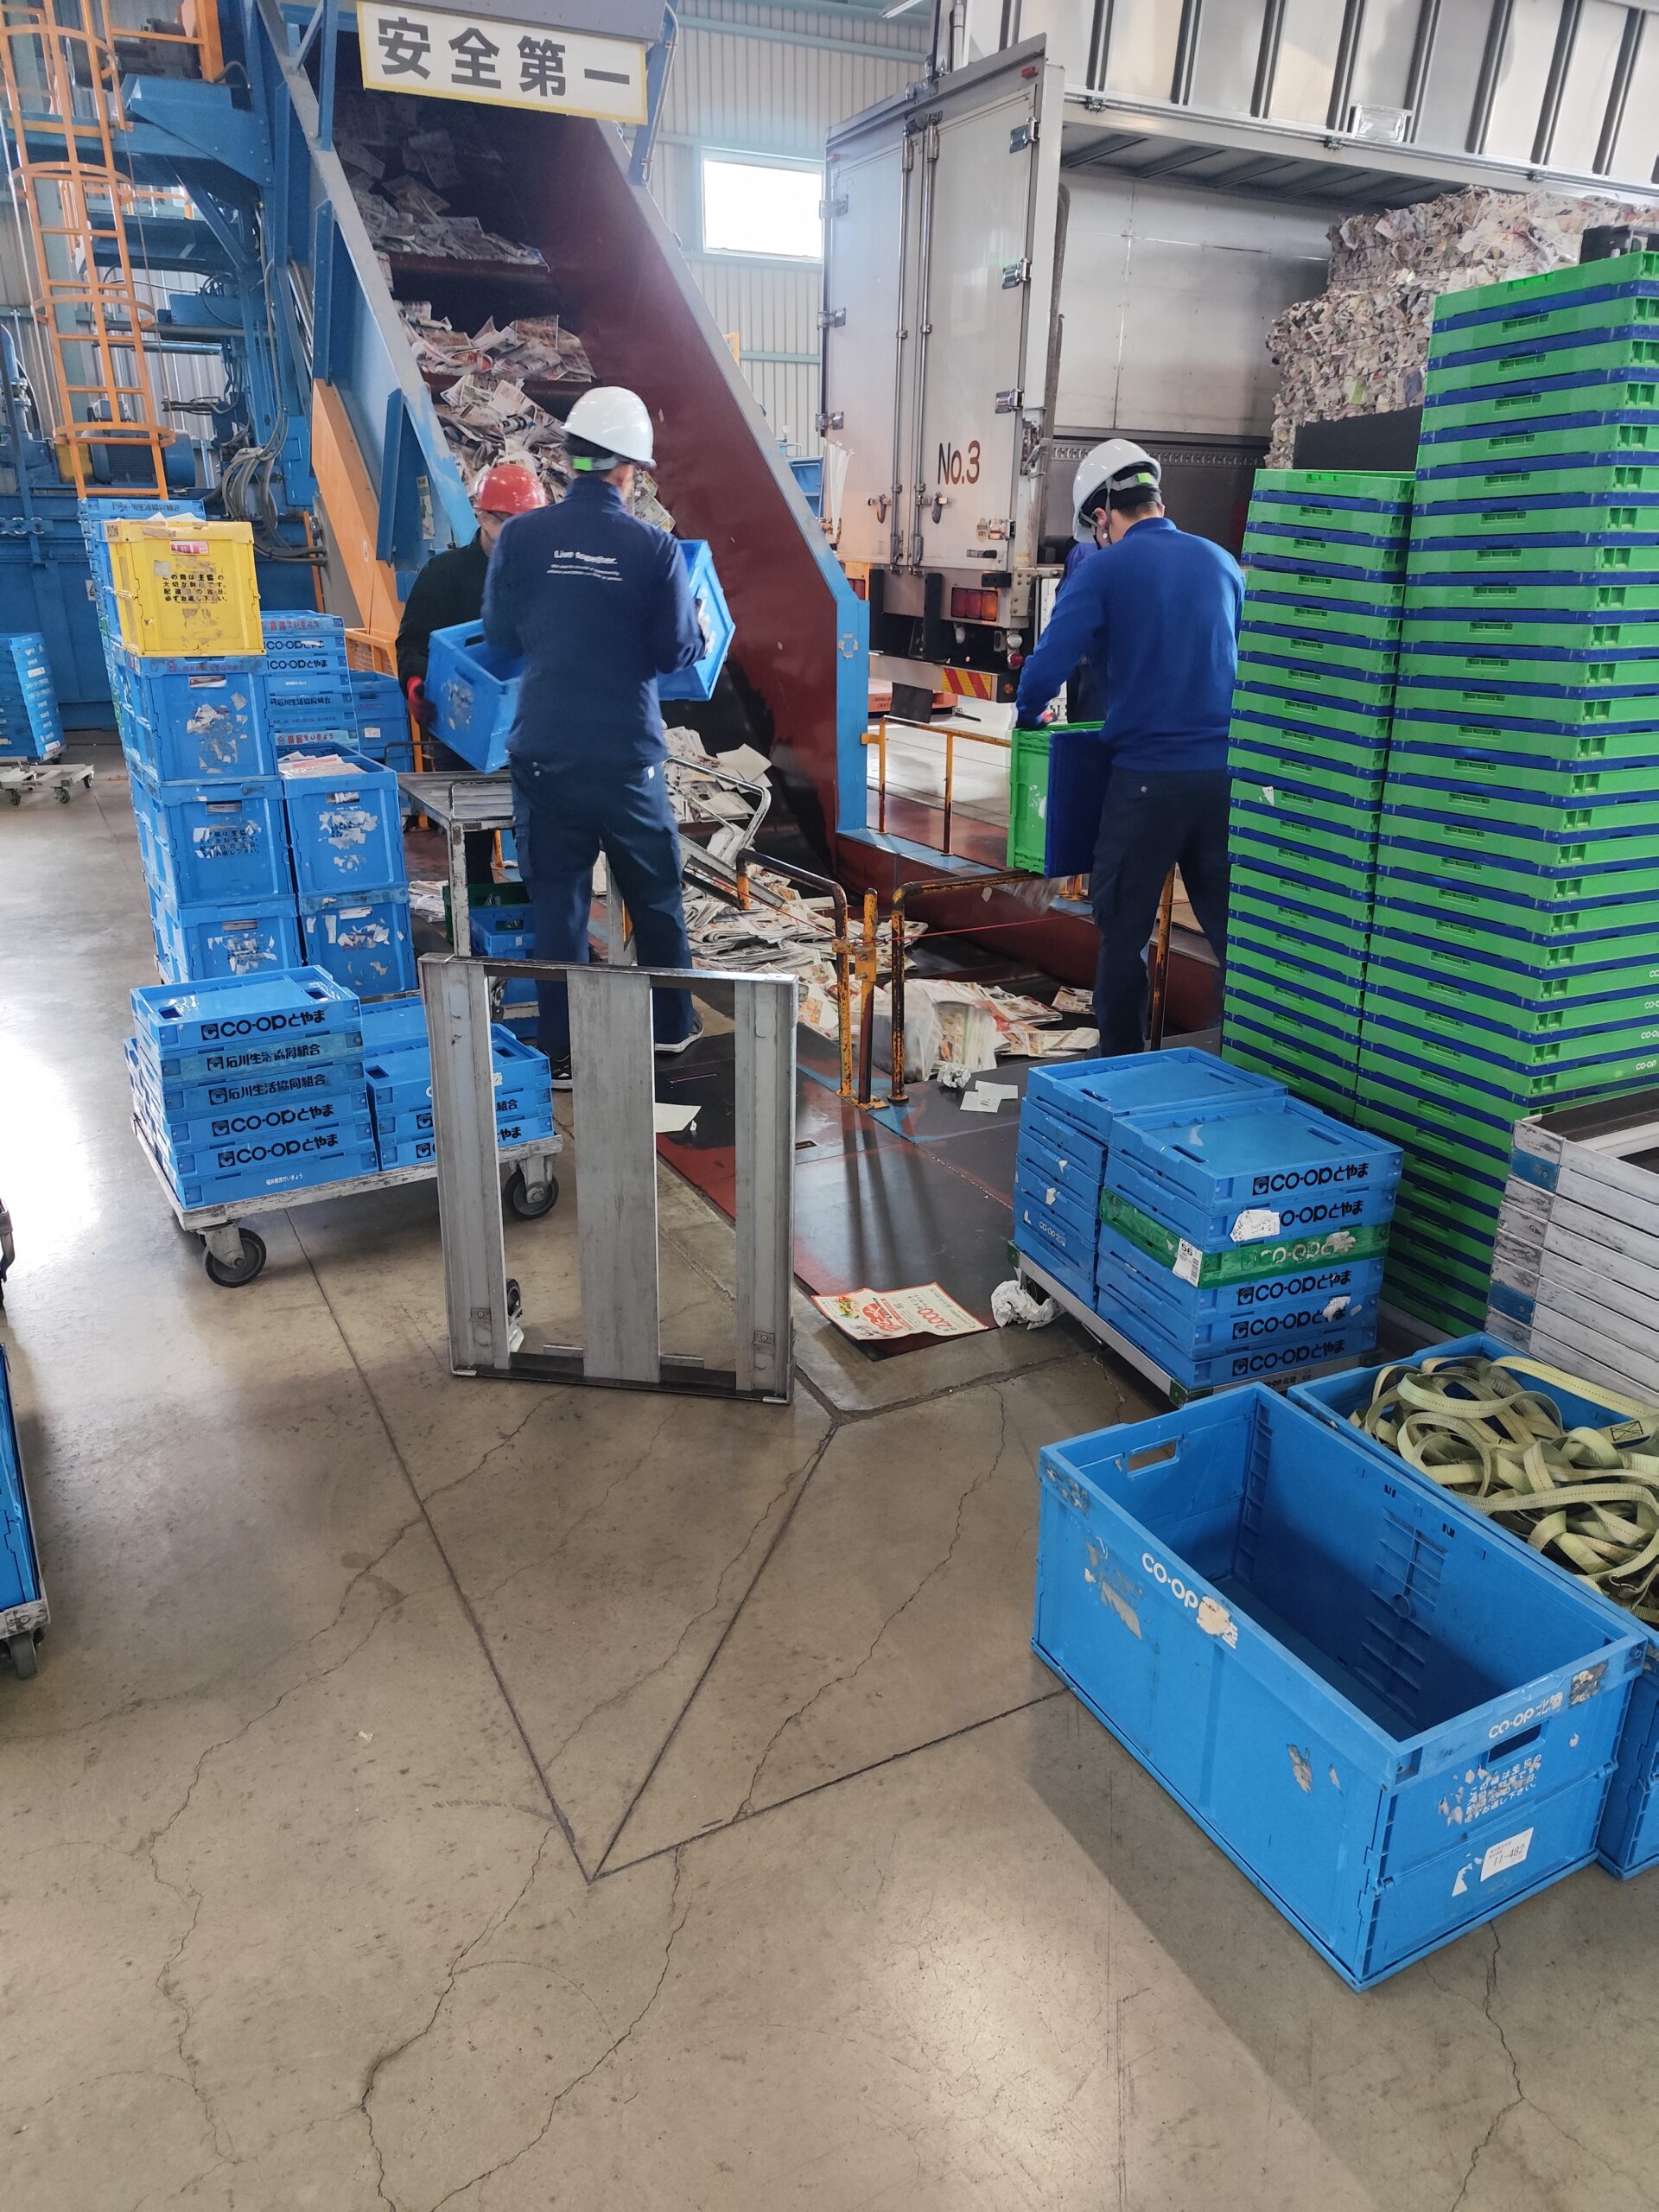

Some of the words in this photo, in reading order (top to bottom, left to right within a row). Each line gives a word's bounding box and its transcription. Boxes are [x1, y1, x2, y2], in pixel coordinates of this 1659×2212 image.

[378, 16, 630, 97] 安全第一
[938, 440, 981, 485] No.3
[220, 1009, 326, 1038] CO-OPとやま
[228, 1074, 326, 1100] 石川生活協同組合
[231, 1103, 334, 1133] CO-OPとやま
[236, 1134, 338, 1164] CO-OPとやま
[1270, 1163, 1369, 1192] CO-OPとやま
[1279, 1200, 1363, 1227] O-OPとやま
[1249, 1340, 1345, 1371] CO-OPとやま
